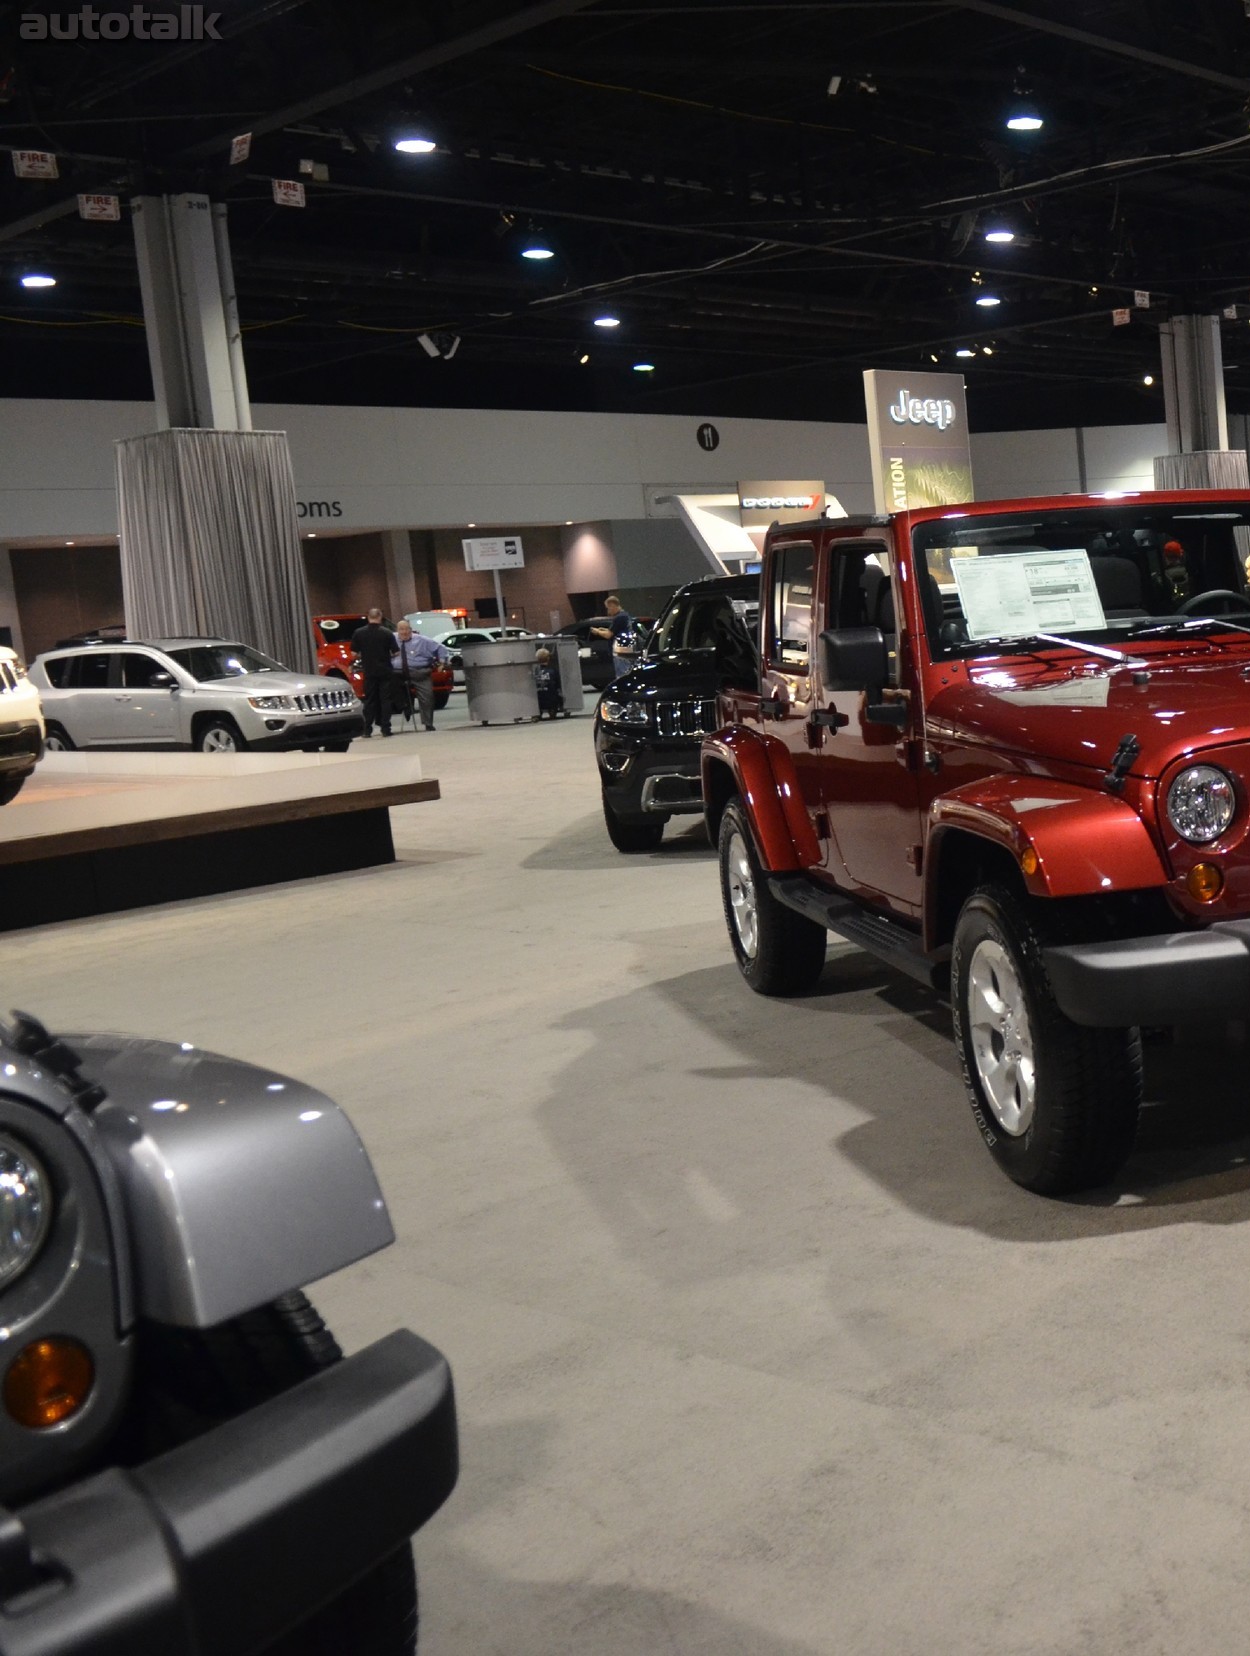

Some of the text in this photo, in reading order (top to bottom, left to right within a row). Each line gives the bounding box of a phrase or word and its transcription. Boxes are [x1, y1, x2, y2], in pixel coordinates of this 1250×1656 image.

[19, 152, 49, 162] FIRE
[277, 181, 299, 192] FIRE
[85, 195, 112, 205] FIRE
[890, 389, 956, 430] Jeep
